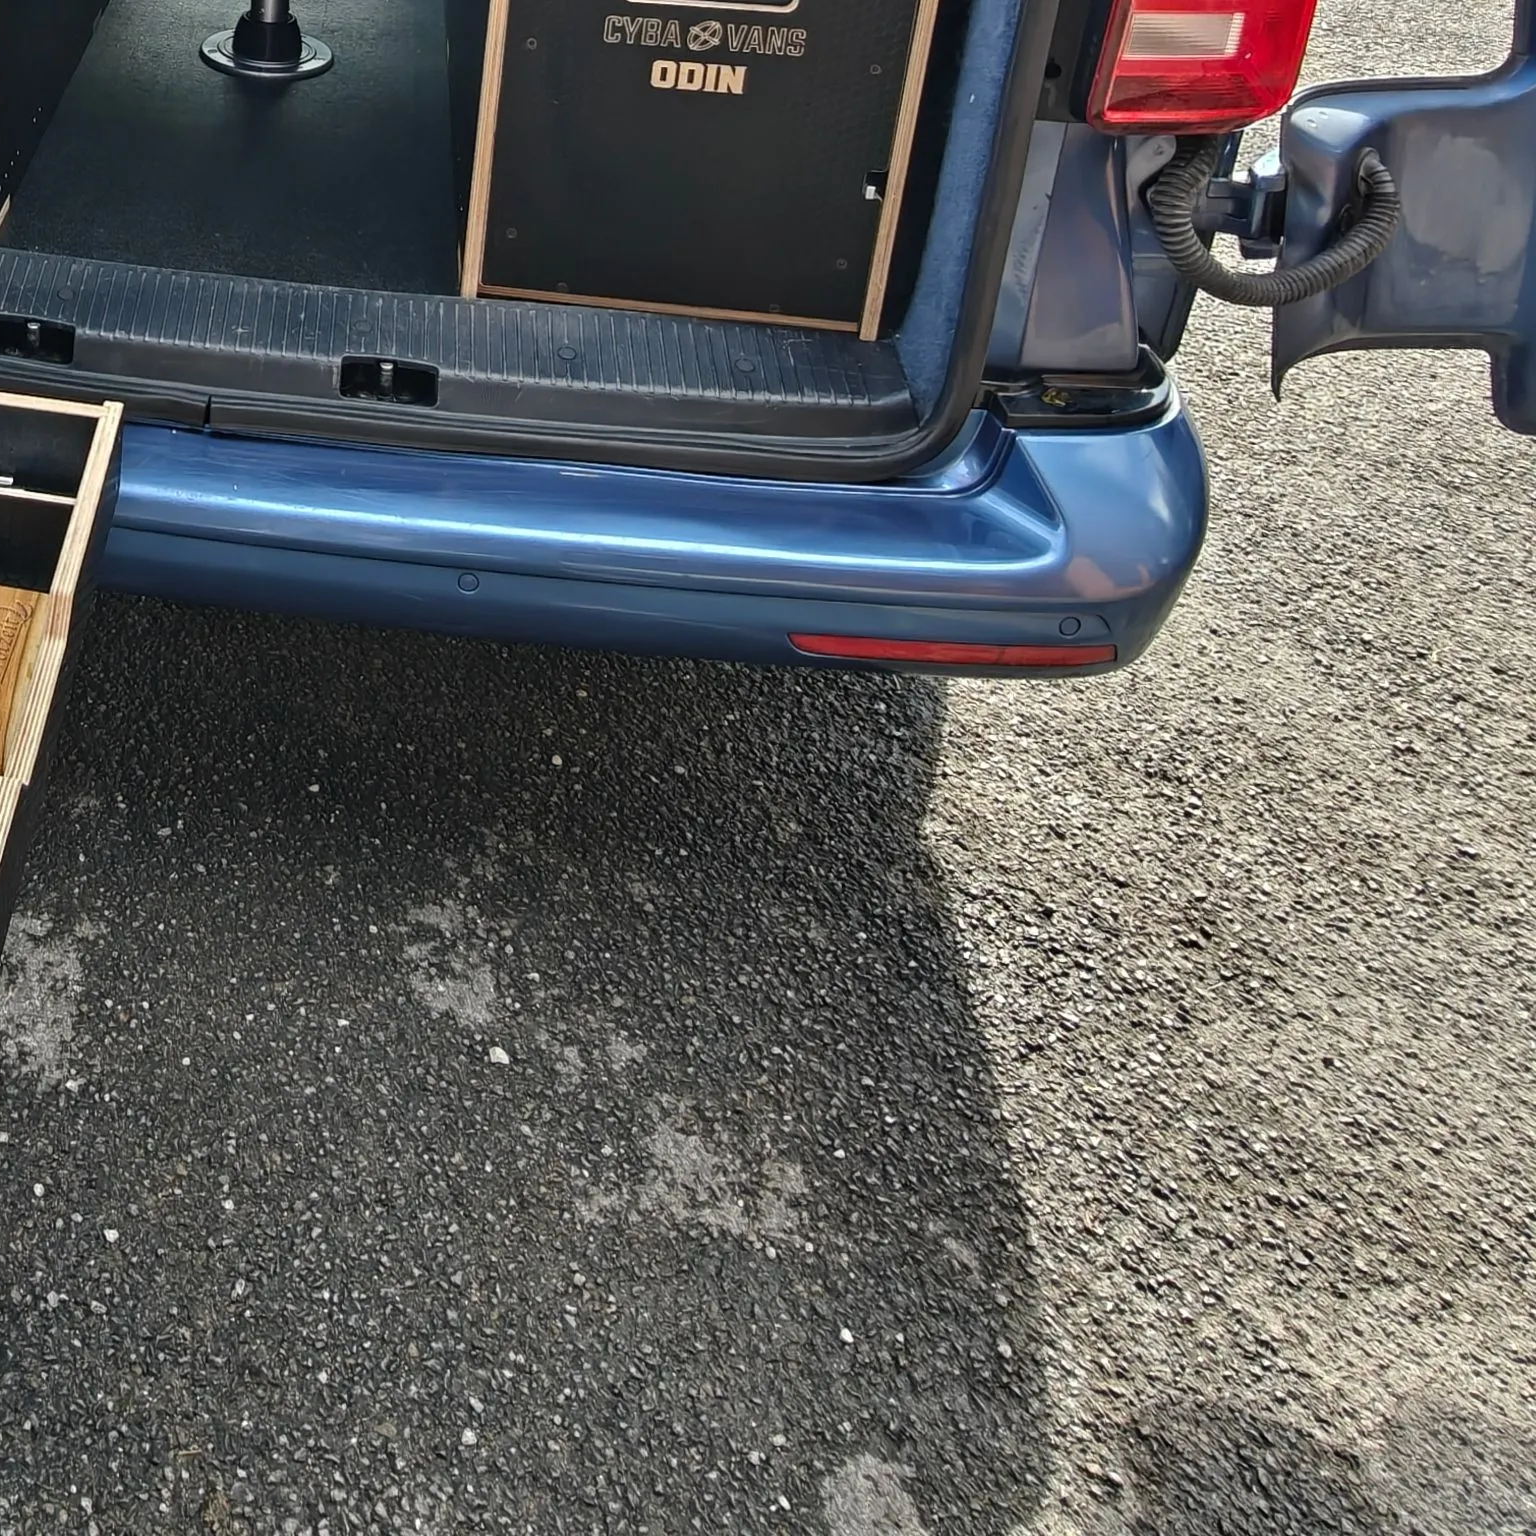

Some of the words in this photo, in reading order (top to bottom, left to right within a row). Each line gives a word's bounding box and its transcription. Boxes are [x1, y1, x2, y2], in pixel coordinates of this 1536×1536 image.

[602, 15, 681, 48] CYBA
[727, 24, 806, 57] VANS
[650, 59, 747, 95] ODIN
